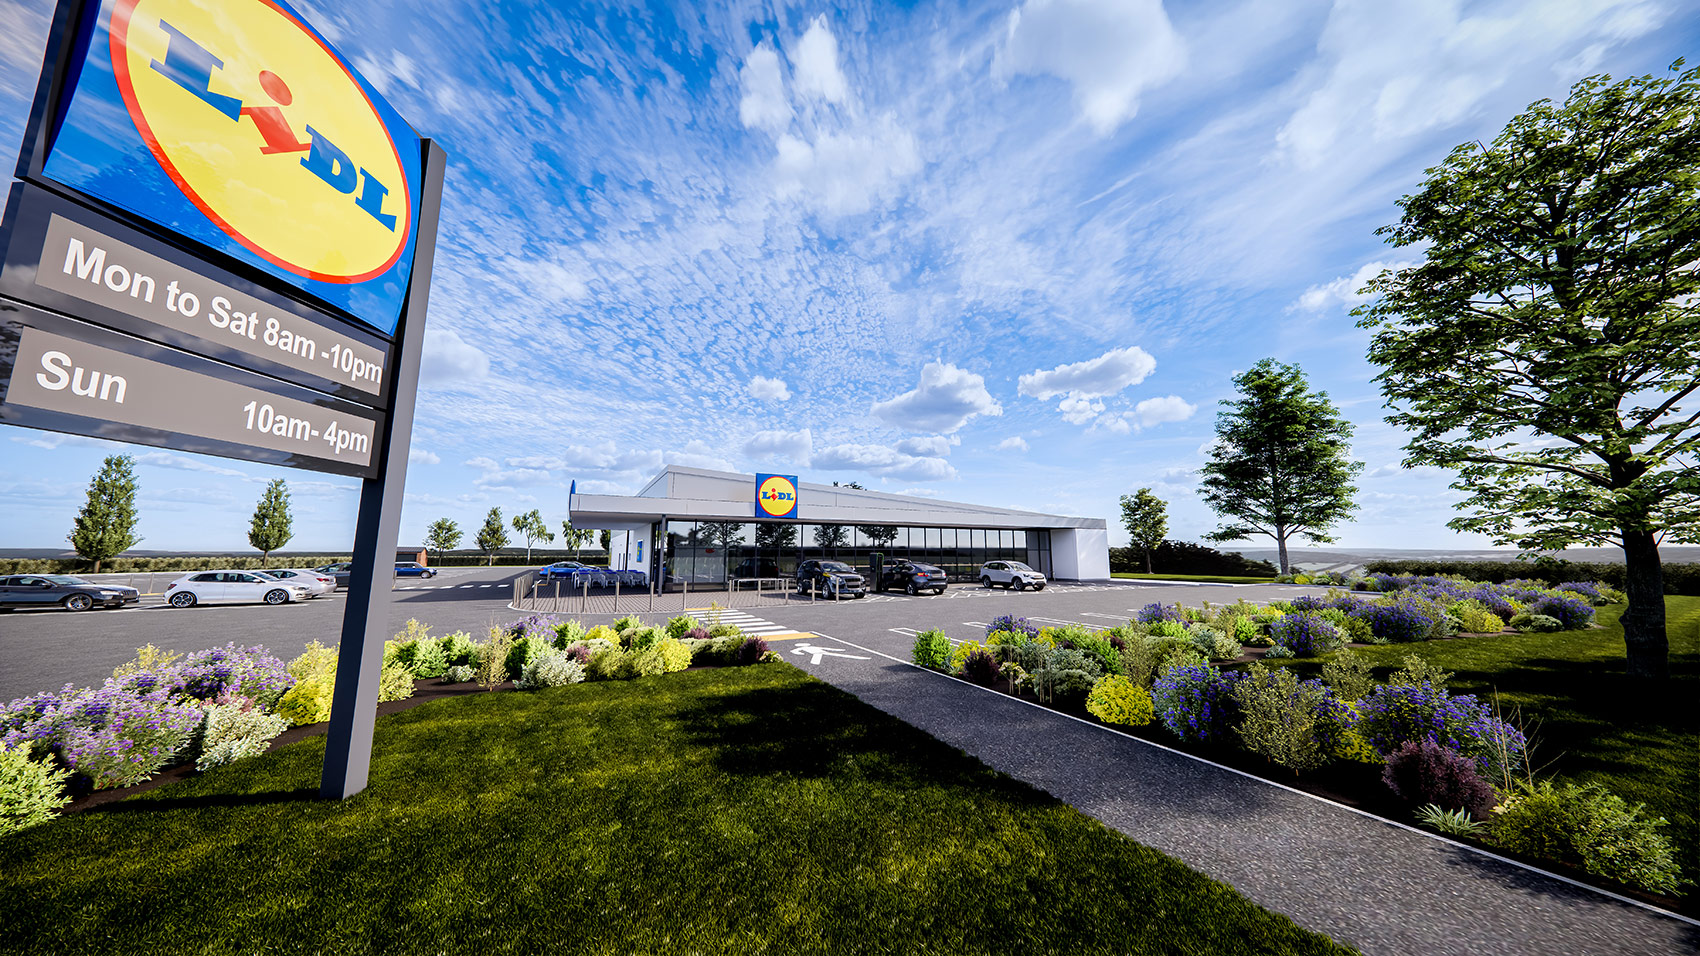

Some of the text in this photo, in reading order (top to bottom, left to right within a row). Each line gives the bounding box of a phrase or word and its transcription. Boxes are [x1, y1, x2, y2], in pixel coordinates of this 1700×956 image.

[63, 237, 155, 303] Mon
[167, 280, 200, 318] to
[208, 295, 259, 341] Sat
[263, 317, 316, 361] 8am
[36, 350, 128, 404] Sun
[324, 416, 368, 454] 4pm
